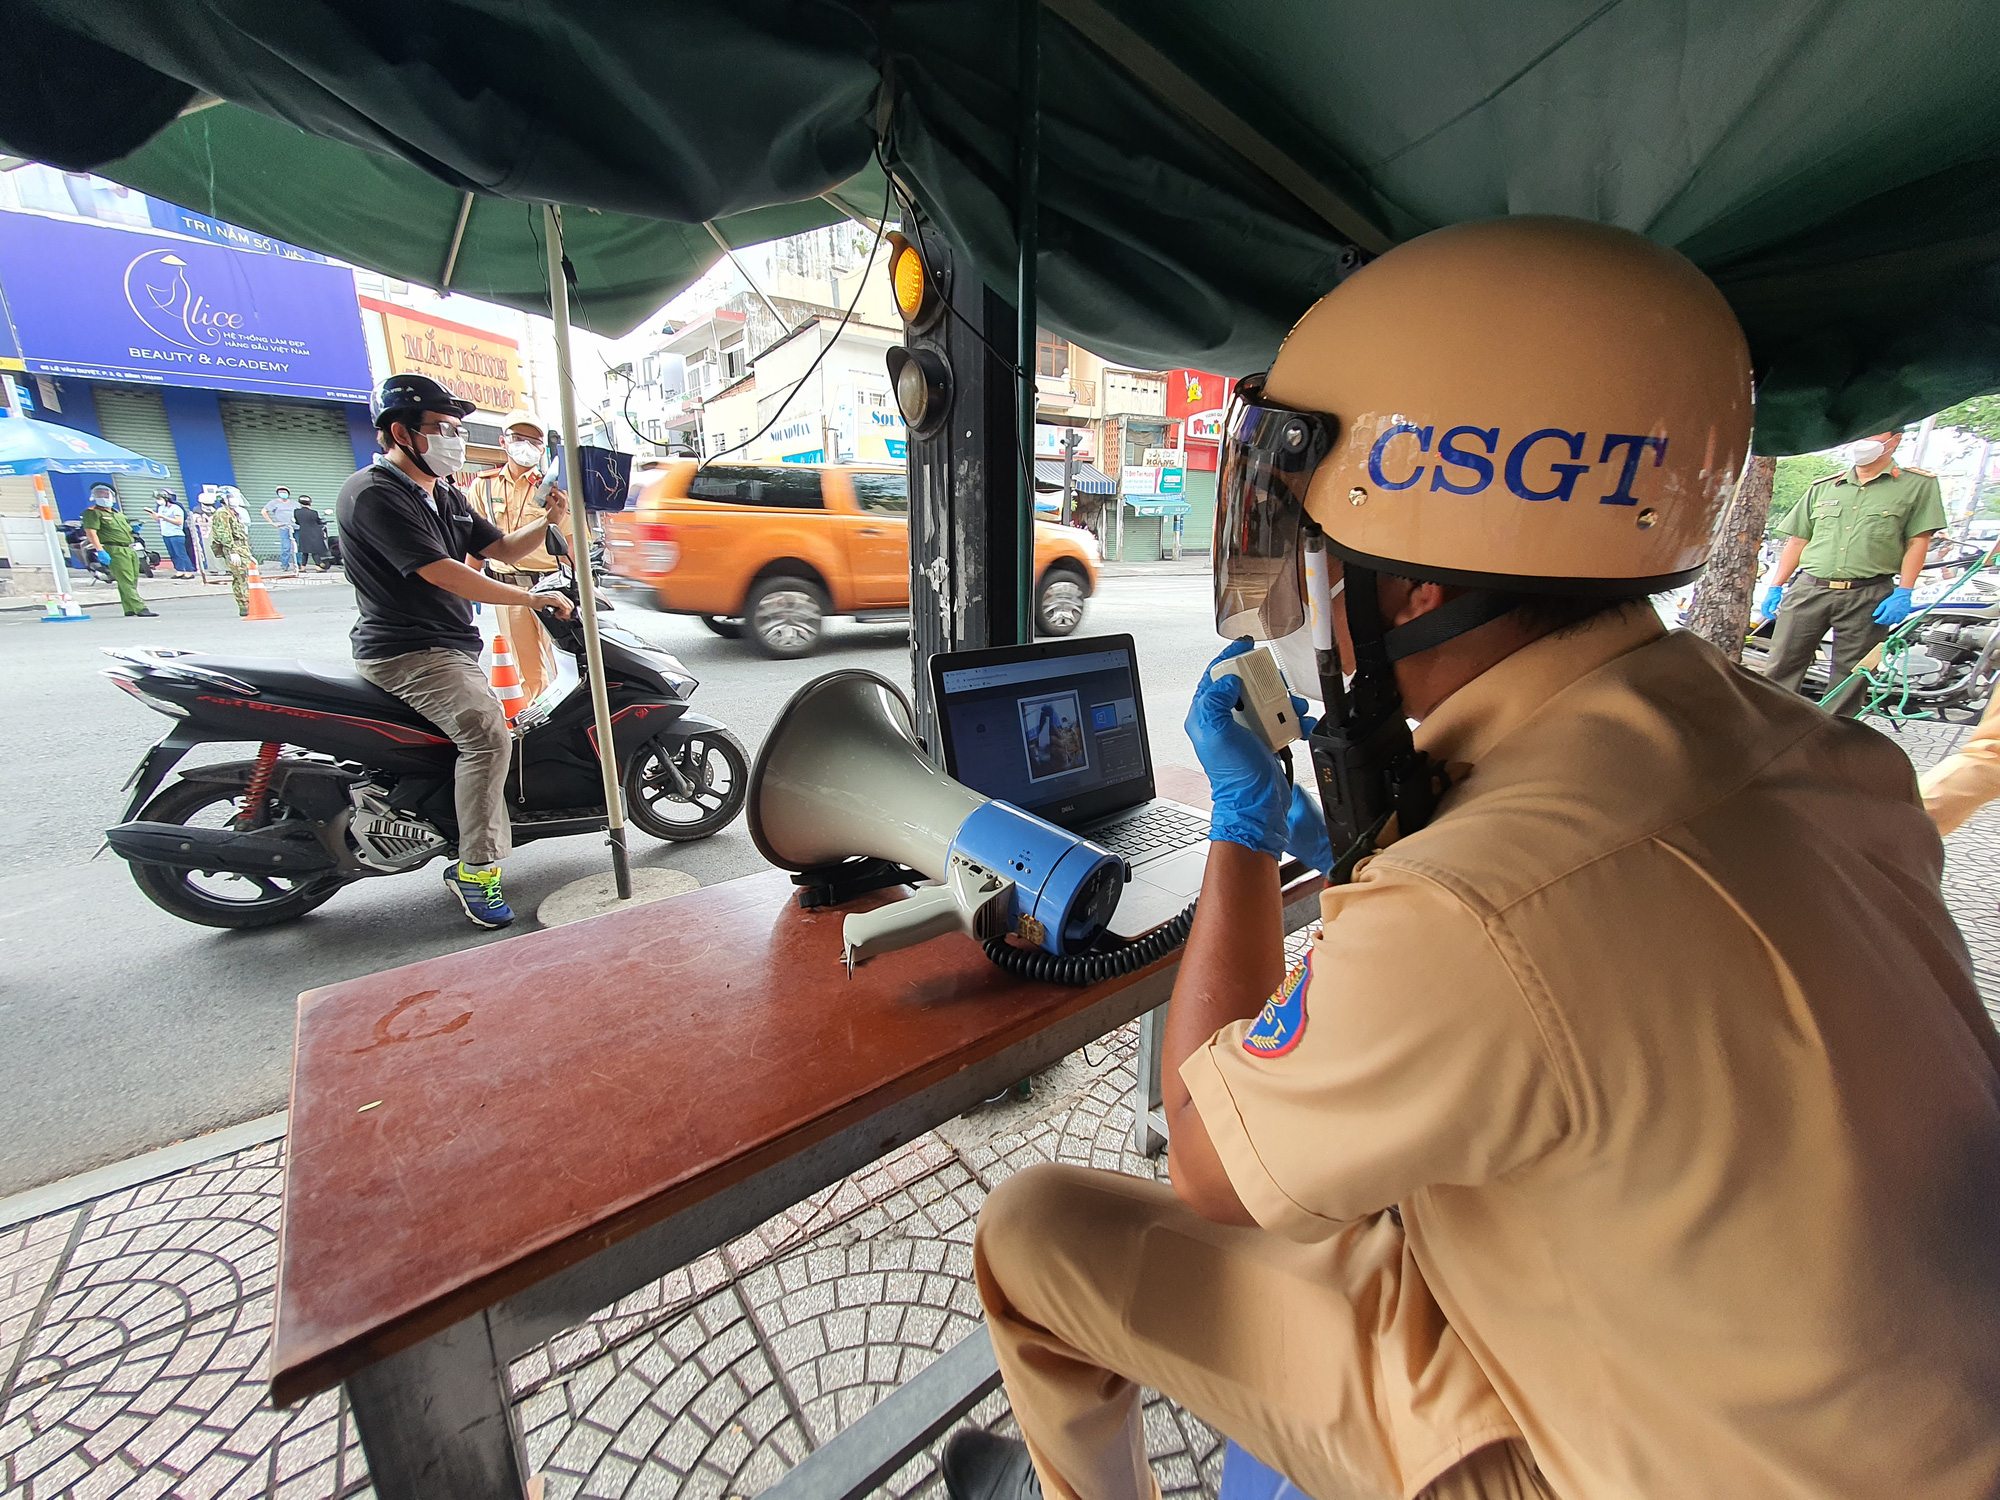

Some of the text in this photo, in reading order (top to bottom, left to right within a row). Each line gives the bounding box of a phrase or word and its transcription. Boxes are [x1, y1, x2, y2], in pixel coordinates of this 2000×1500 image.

[181, 216, 211, 236] TRỊ
[274, 243, 280, 255] 1
[224, 339, 250, 350] HÀNG
[270, 344, 289, 355] VIỆT
[291, 348, 311, 356] NAM
[270, 335, 288, 346] LÀM
[128, 347, 290, 373] BEAUTY & ACADEMY
[402, 327, 510, 382] MẮT KÍNH
[483, 384, 515, 409] PHÁT
[1367, 425, 1669, 507] CSGT
[1061, 804, 1075, 814] DELL
